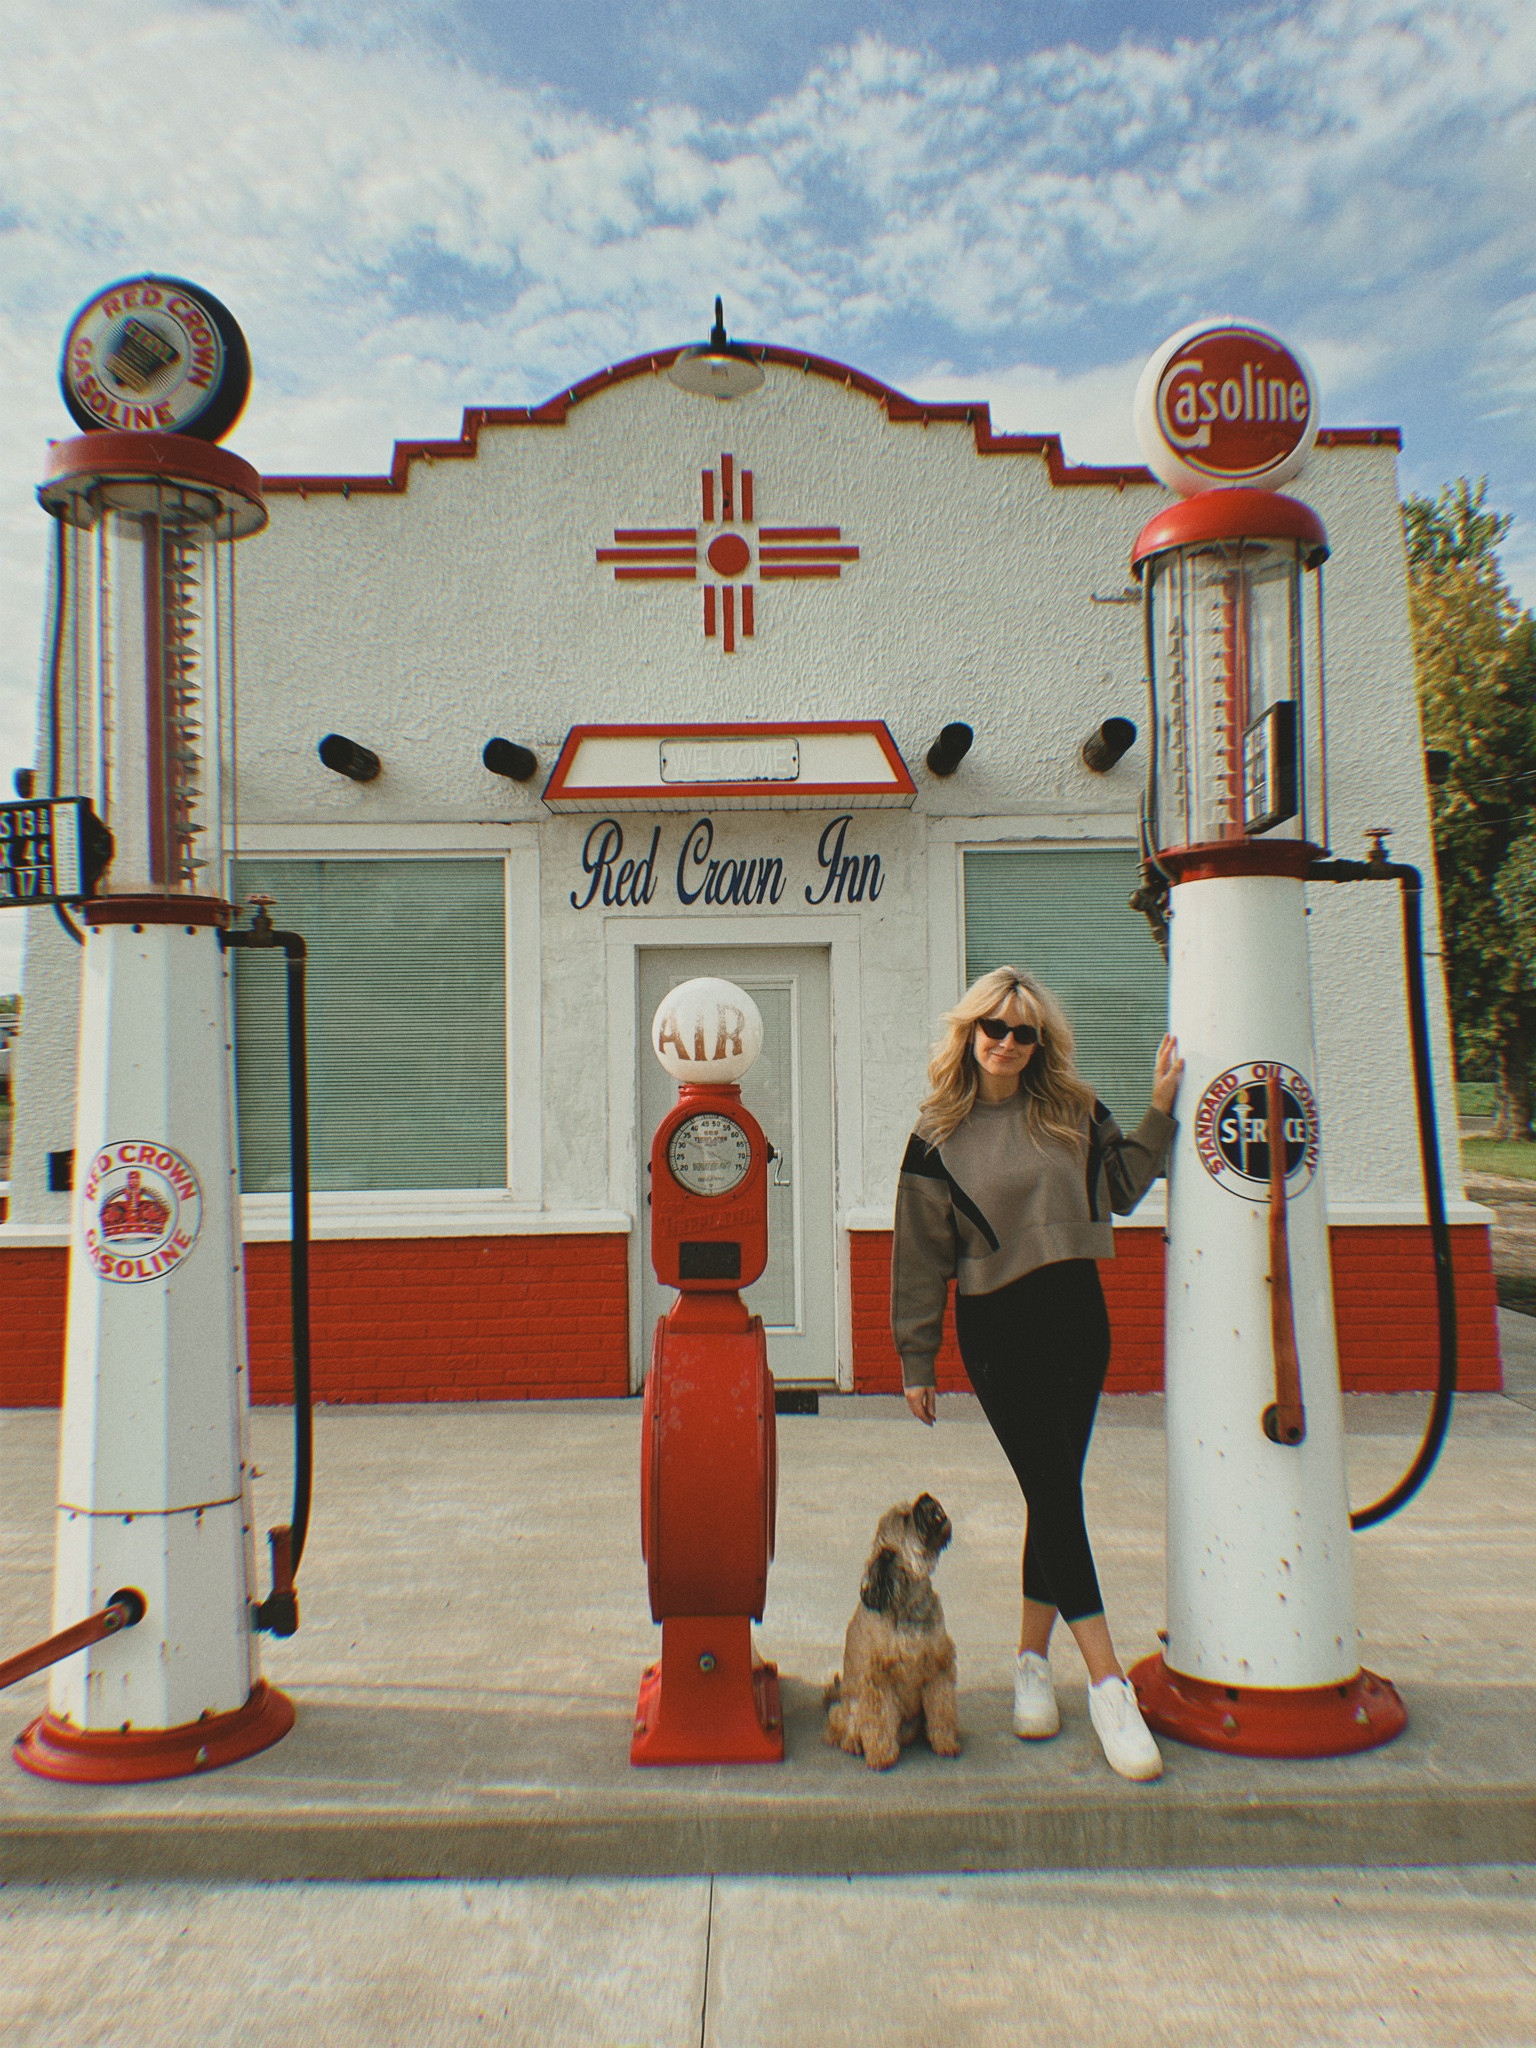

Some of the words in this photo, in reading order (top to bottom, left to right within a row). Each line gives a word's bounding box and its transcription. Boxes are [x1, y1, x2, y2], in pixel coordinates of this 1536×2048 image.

[75, 338, 178, 430] GASOLINE
[102, 289, 163, 319] RED
[167, 297, 216, 390] CROWN
[1157, 358, 1309, 449] Gasoline
[671, 743, 789, 775] WELCOME
[570, 818, 661, 910] Red
[676, 818, 787, 906] Crown
[805, 815, 886, 905] Inn
[658, 1001, 746, 1062] AIR
[1198, 1073, 1238, 1175] STANDARD
[1290, 1076, 1320, 1178] COMPANY
[1220, 1118, 1307, 1144] SERCE
[85, 1154, 113, 1201] RED
[118, 1145, 197, 1201] CROWN
